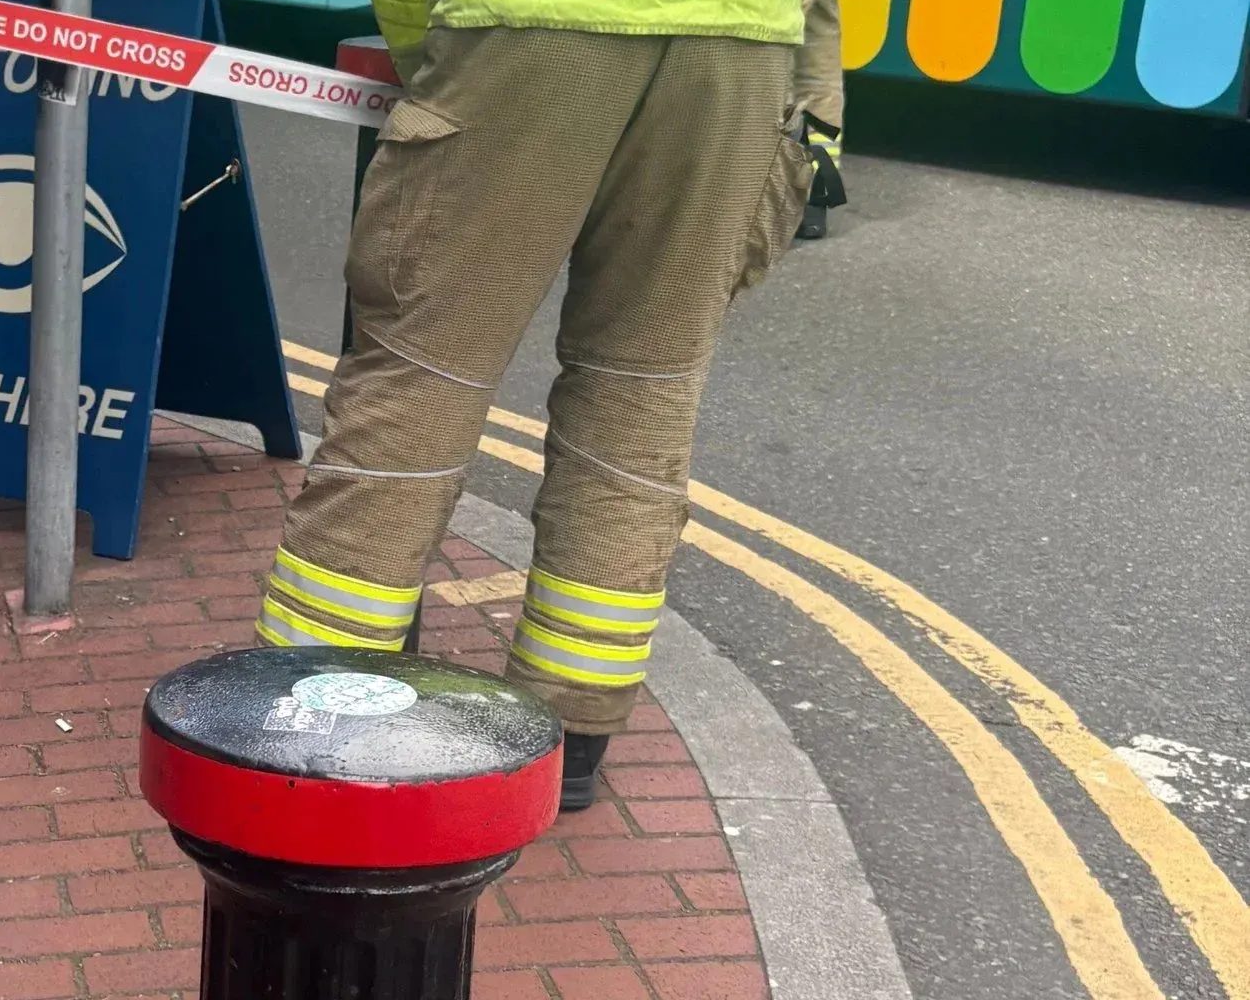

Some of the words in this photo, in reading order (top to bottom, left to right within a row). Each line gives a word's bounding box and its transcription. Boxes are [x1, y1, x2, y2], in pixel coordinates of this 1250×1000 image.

[13, 19, 48, 43] DO
[53, 26, 103, 53] NOT
[106, 37, 187, 72] CROSS
[228, 61, 308, 94] CROSS
[312, 81, 362, 106] NOT
